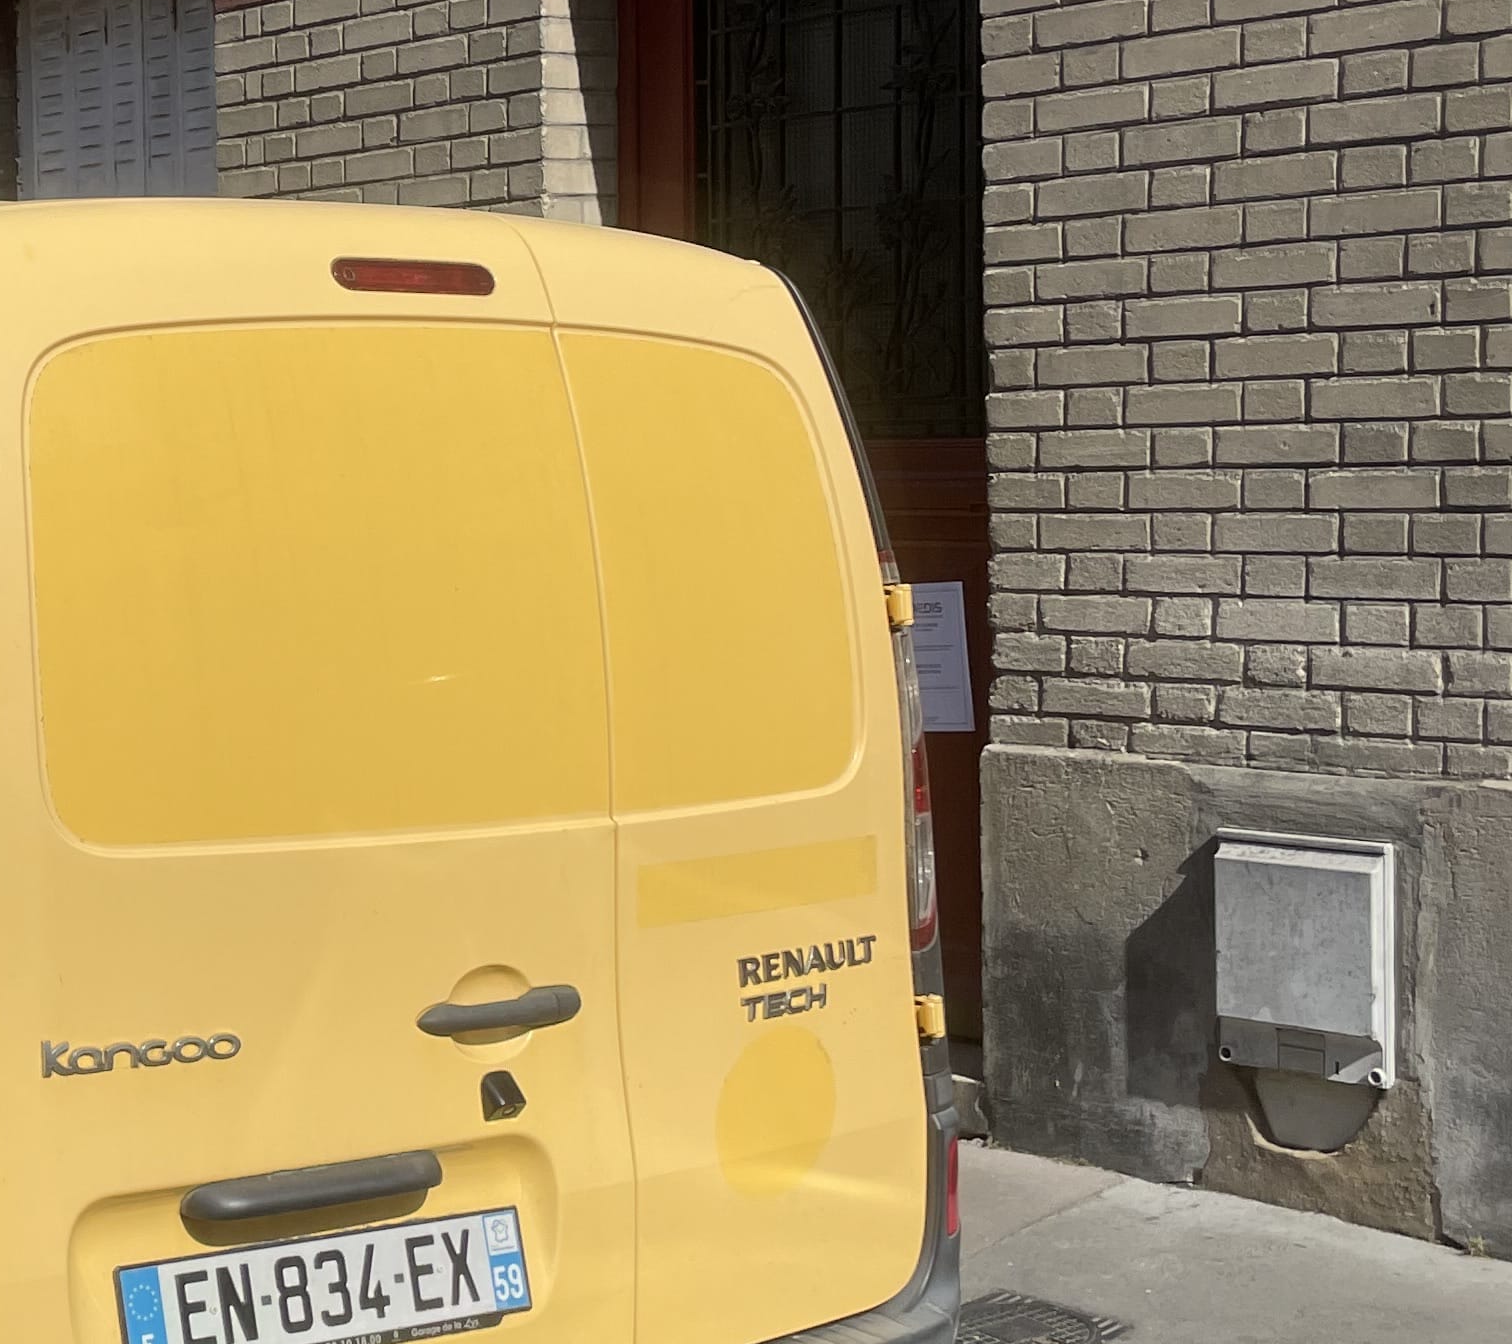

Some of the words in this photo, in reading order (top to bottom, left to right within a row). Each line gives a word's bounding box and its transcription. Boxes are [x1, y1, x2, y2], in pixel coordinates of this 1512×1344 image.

[736, 934, 877, 988] RENAULT
[740, 982, 827, 1023] TECH
[492, 1263, 524, 1302] 59
[410, 1325, 441, 1337] Garage
[442, 1321, 453, 1332] de
[453, 1320, 462, 1330] la
